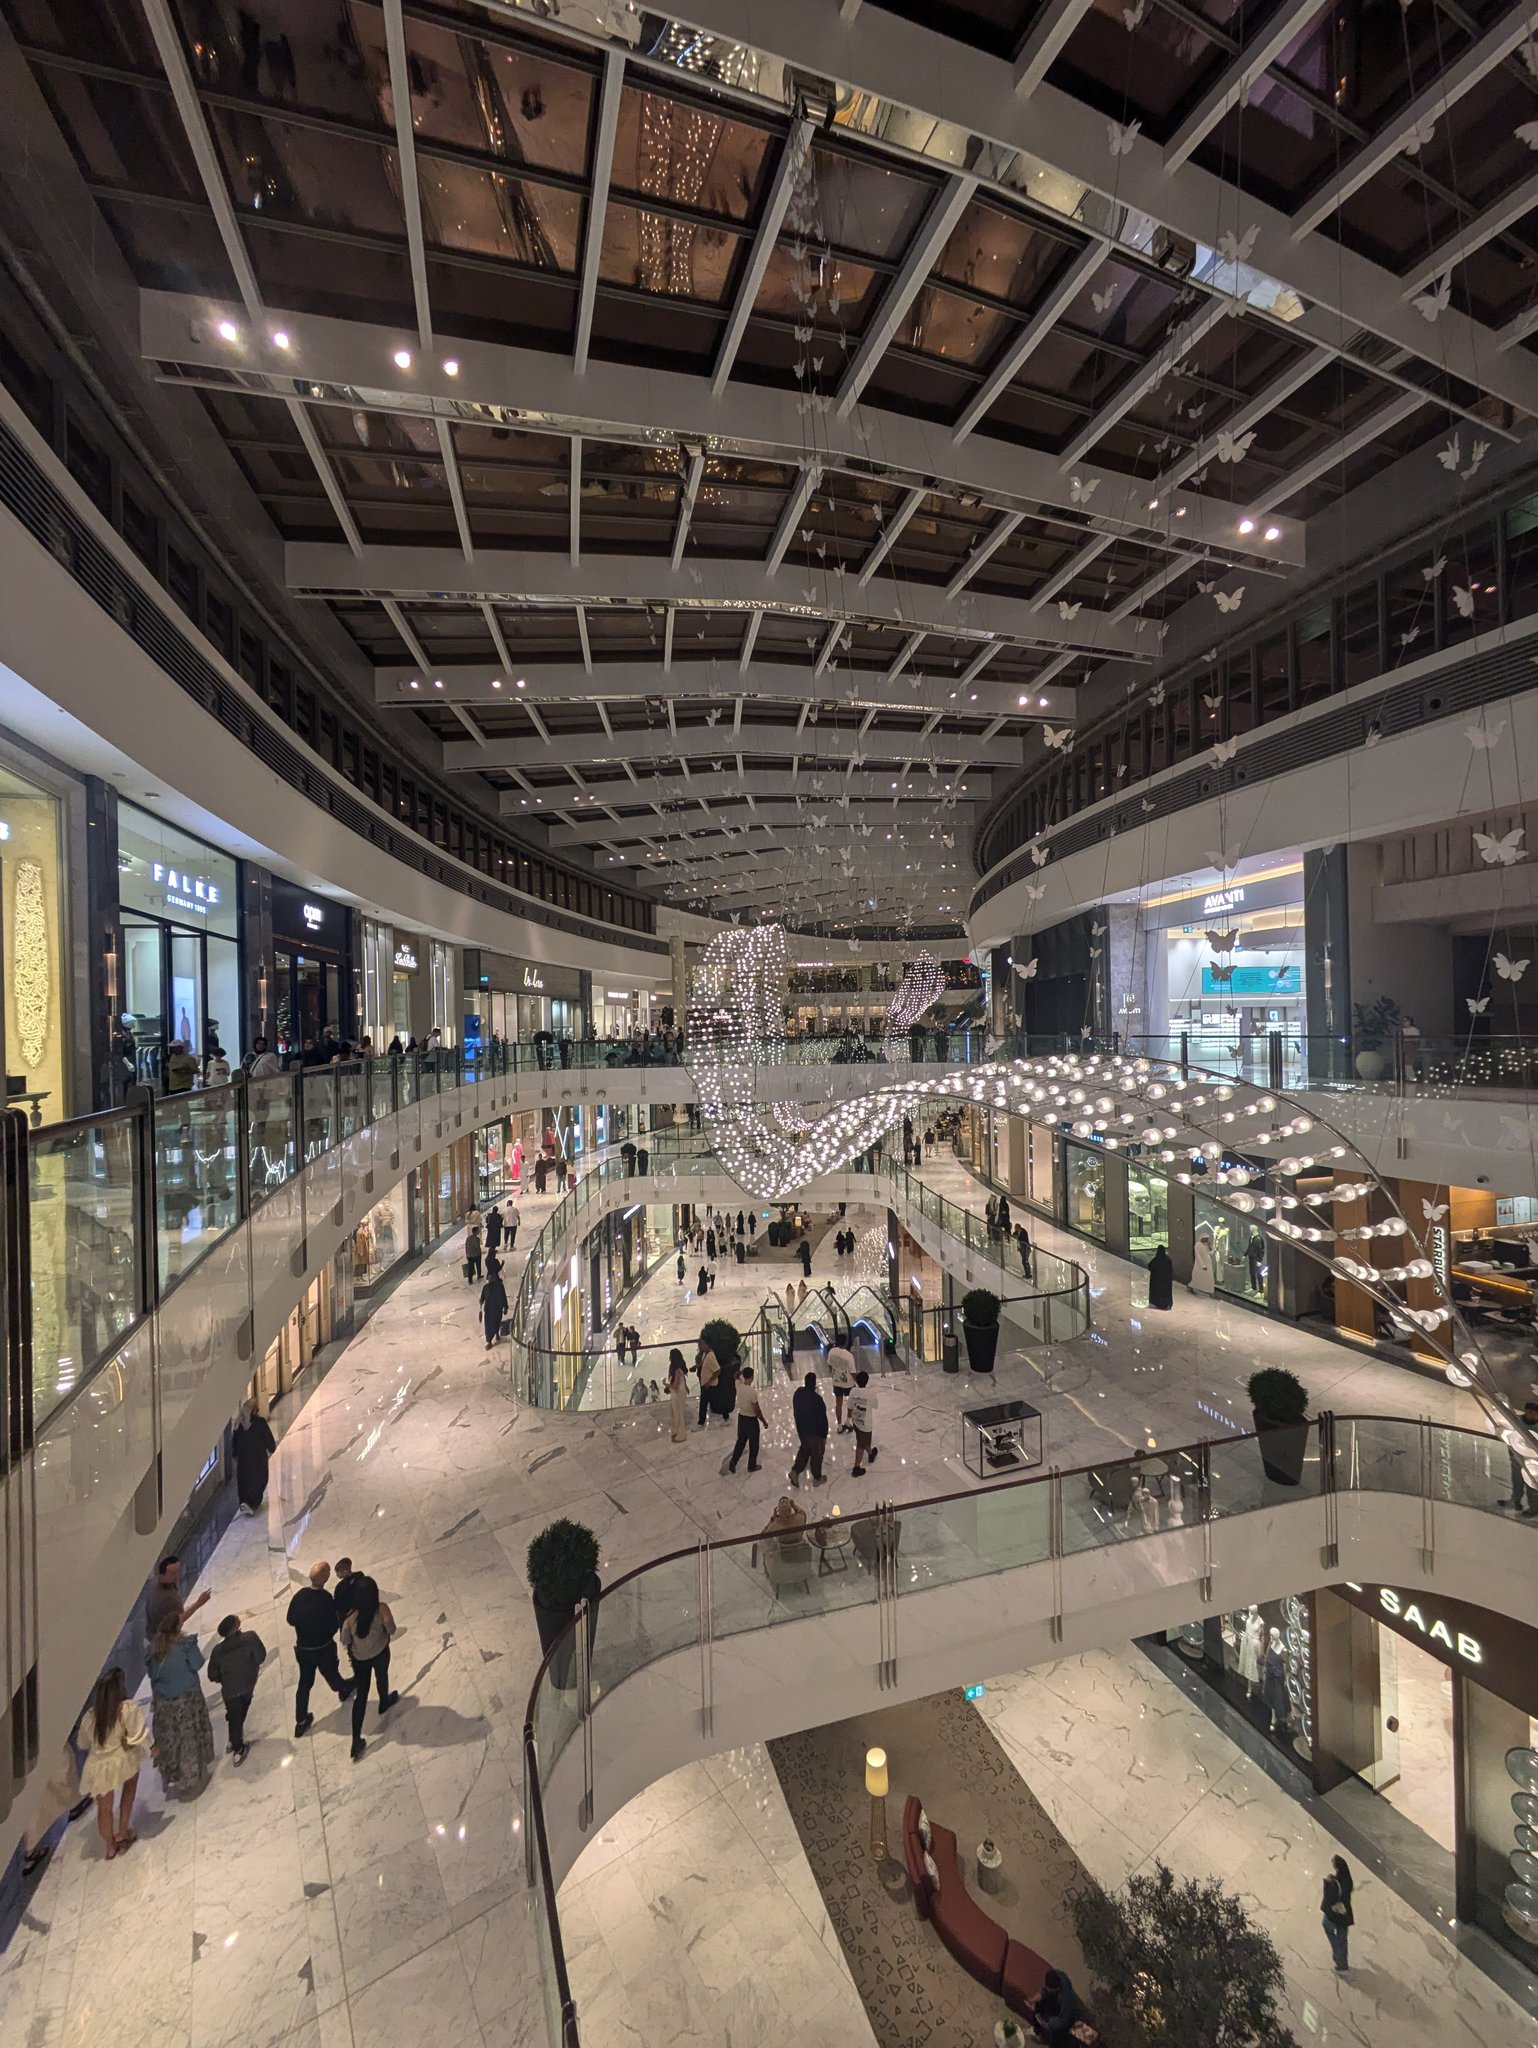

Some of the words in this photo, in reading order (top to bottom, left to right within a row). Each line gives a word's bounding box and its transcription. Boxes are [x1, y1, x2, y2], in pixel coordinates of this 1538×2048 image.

[153, 862, 218, 903] FALKE
[1433, 1226, 1446, 1297] STARBUS
[1380, 1588, 1482, 1664] SAAB
